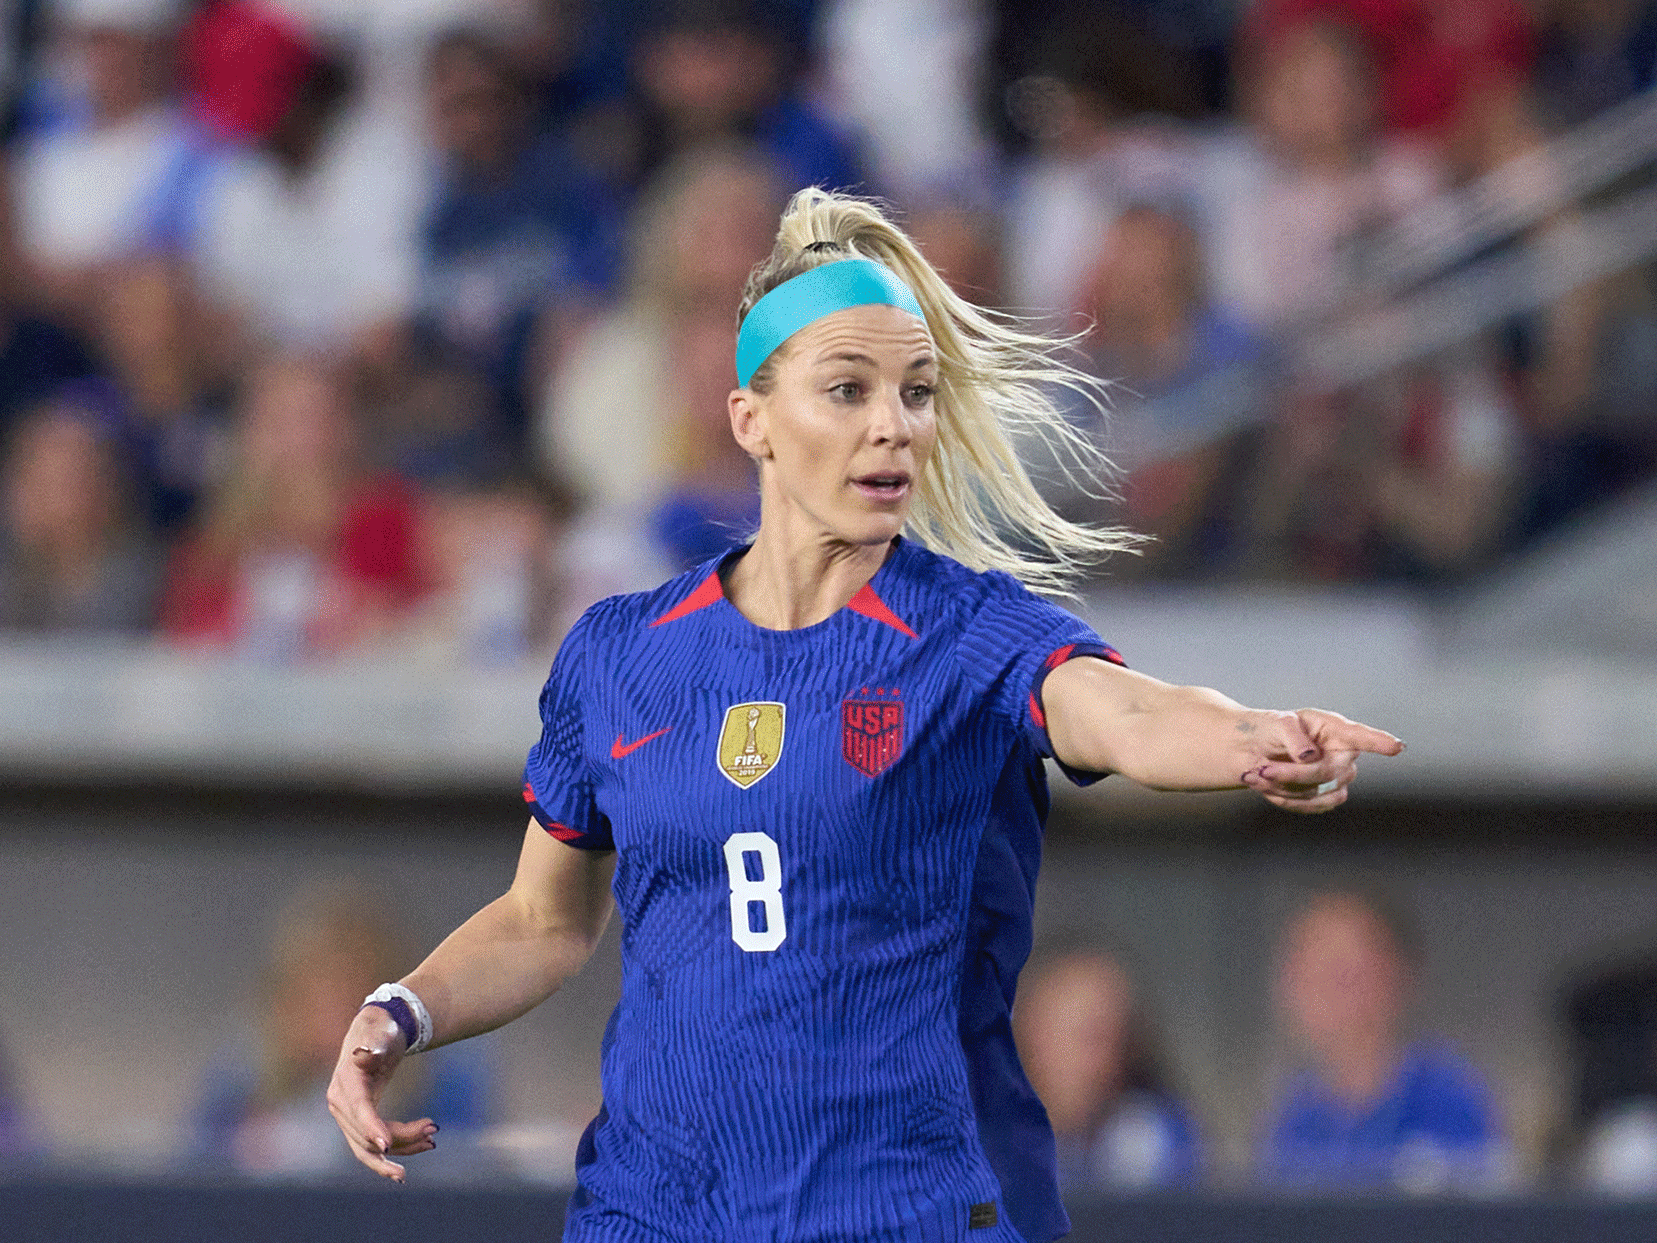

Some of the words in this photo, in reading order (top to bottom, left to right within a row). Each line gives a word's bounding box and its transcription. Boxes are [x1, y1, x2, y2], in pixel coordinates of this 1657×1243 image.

[847, 705, 898, 735] USA
[734, 754, 762, 766] FIFA
[723, 831, 787, 952] 8
